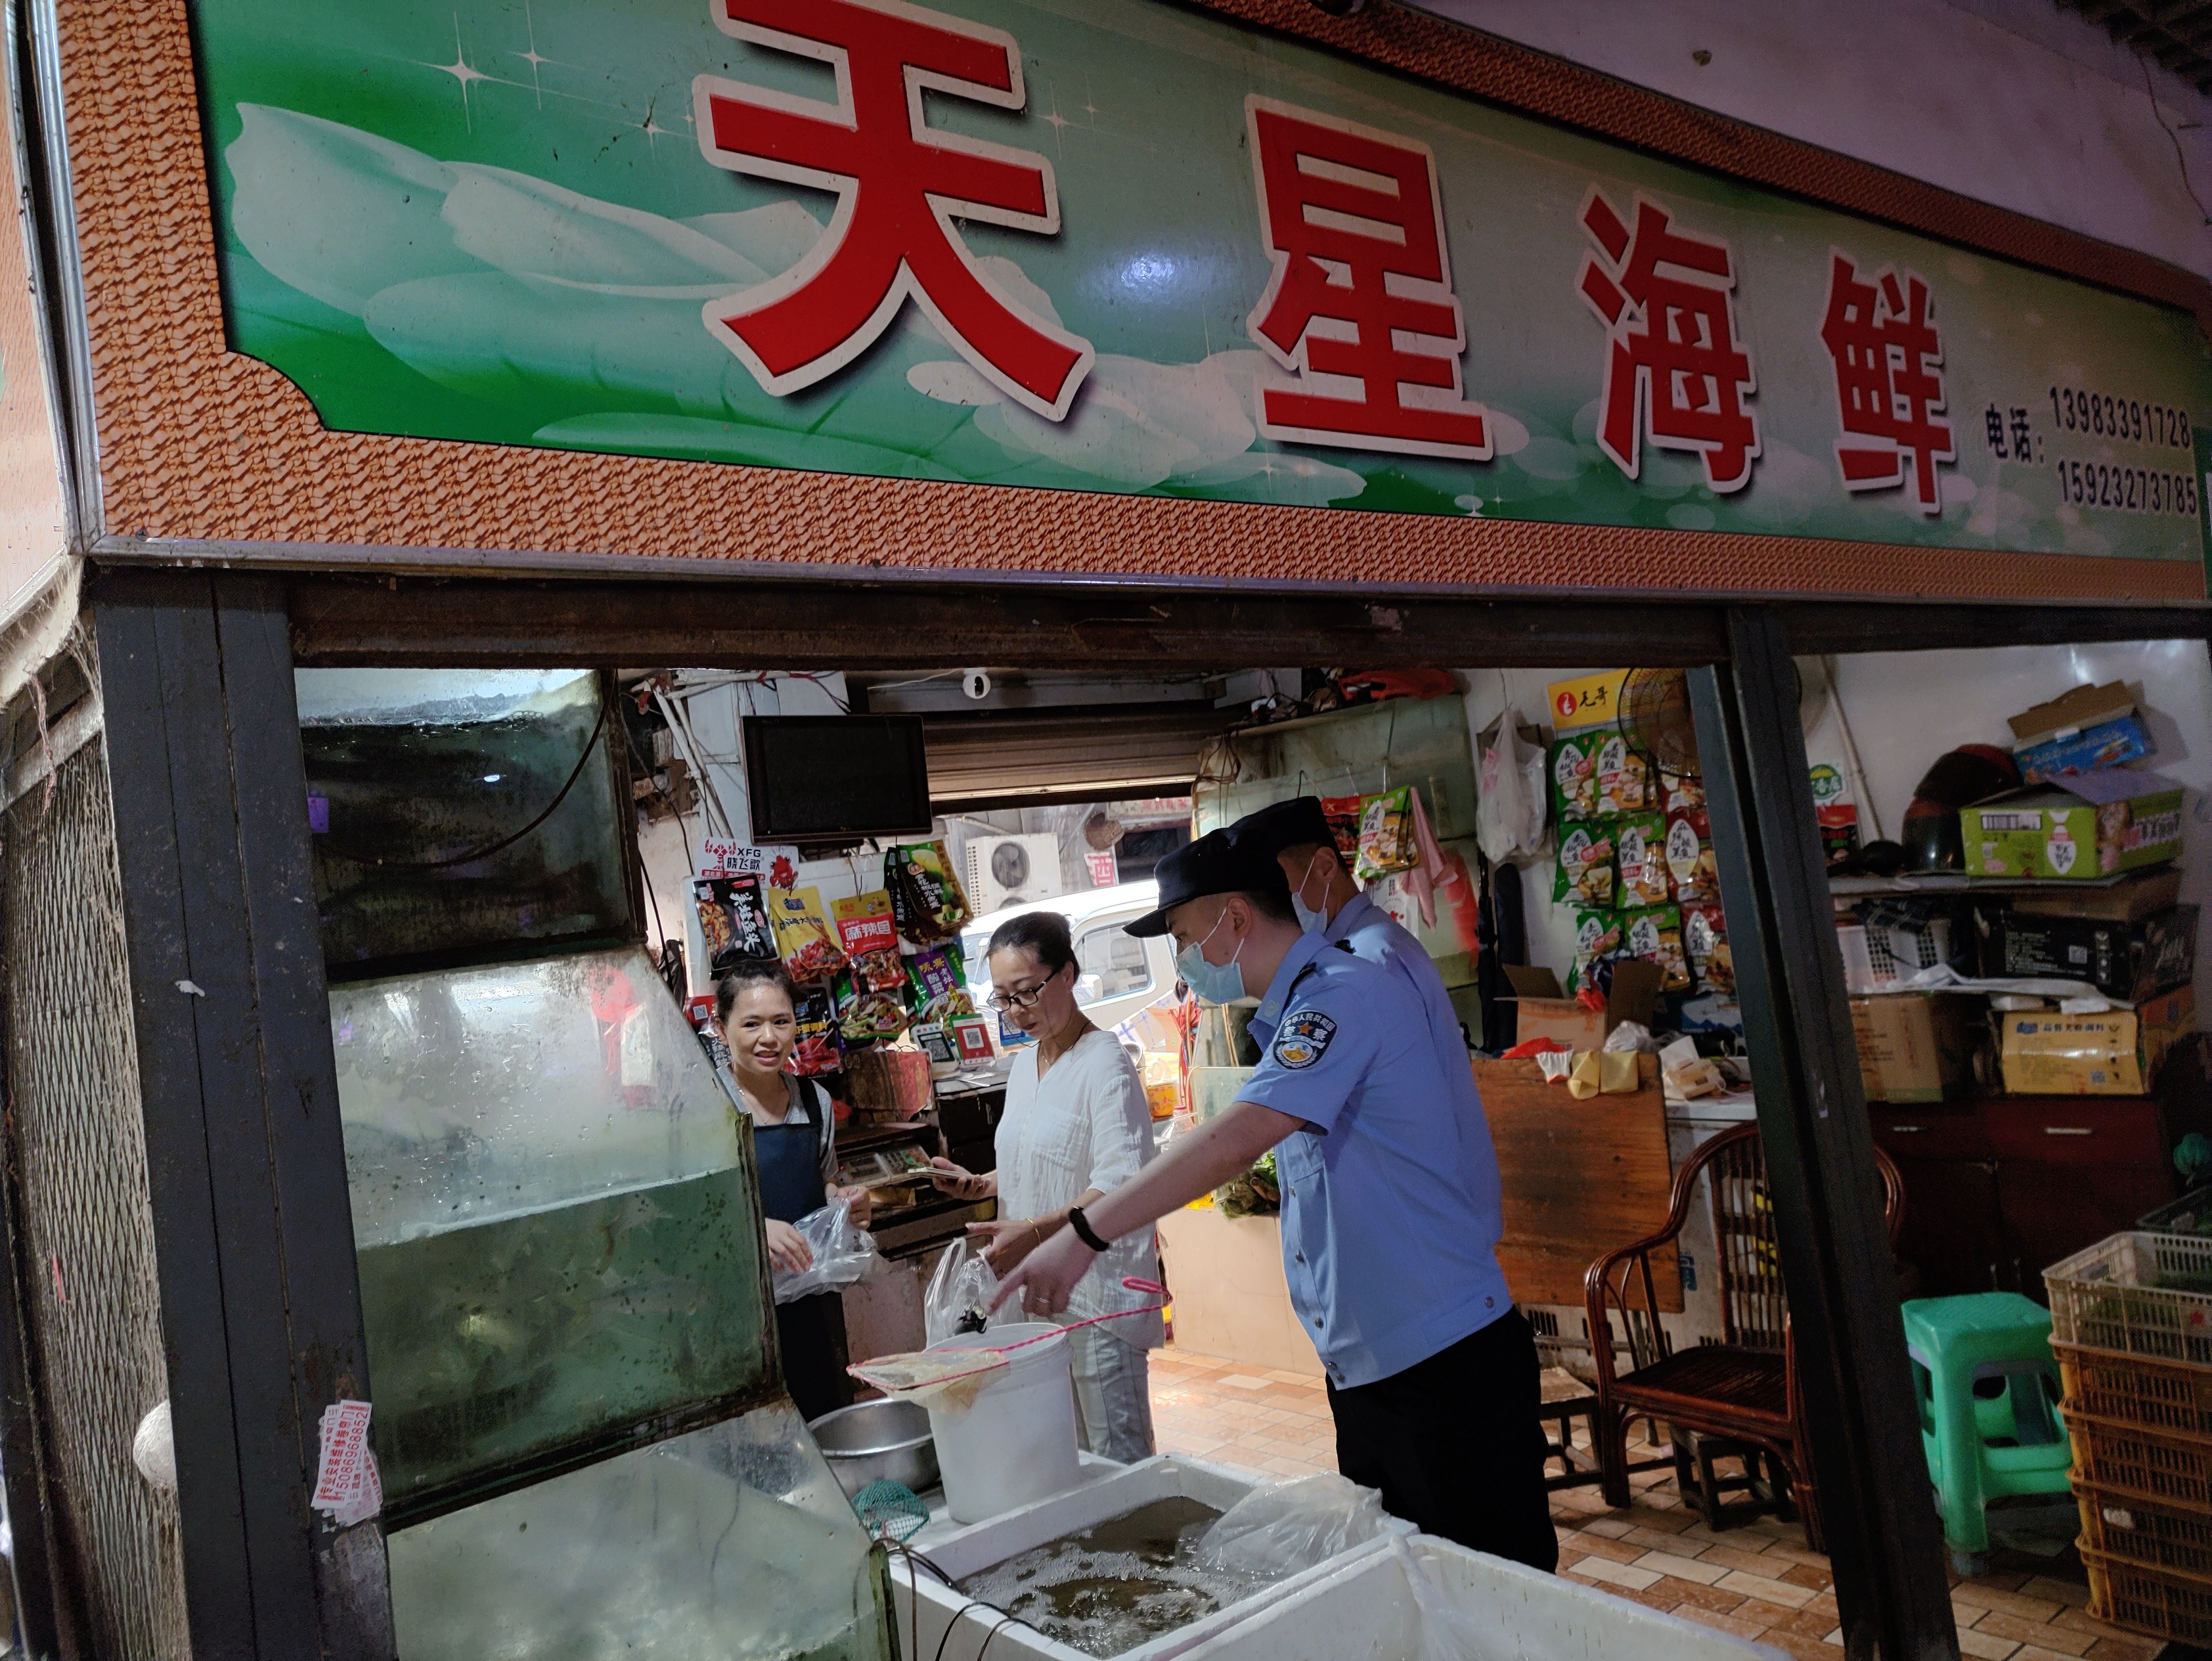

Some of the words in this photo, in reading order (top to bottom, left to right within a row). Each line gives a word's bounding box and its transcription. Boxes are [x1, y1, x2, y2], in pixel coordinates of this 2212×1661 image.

[692, 0, 1958, 517] 天星海鲜
[2049, 386, 2191, 450] 13983391728
[2058, 460, 2197, 515] 15923273785
[727, 857, 761, 871] 晓飞歌
[737, 848, 761, 857] XFG
[845, 919, 892, 941] 麻辣鱼
[1284, 1013, 1336, 1032] 中华人民共和国
[334, 1411, 368, 1497] 15086968852
